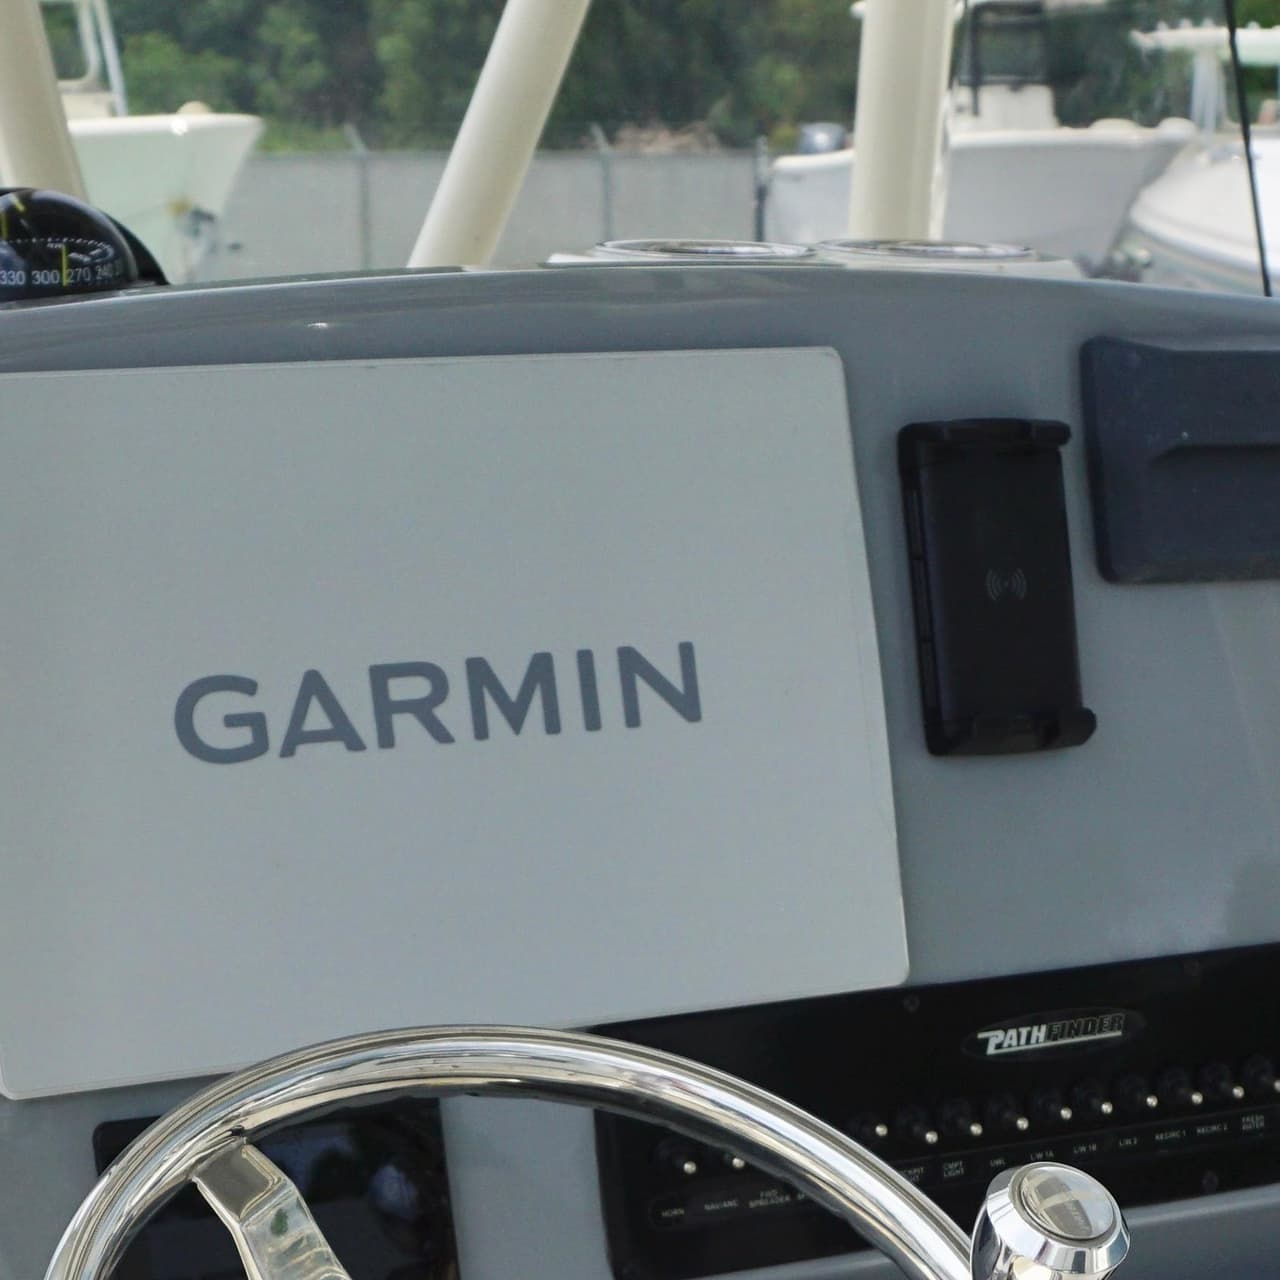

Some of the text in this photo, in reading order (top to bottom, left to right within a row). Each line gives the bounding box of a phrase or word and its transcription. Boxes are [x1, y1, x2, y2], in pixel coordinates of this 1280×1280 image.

[0, 271, 26, 285] 330
[32, 270, 60, 284] 300
[68, 268, 91, 282] 270
[173, 641, 702, 764] GARMIN
[977, 1013, 1126, 1055] PATHFINDER
